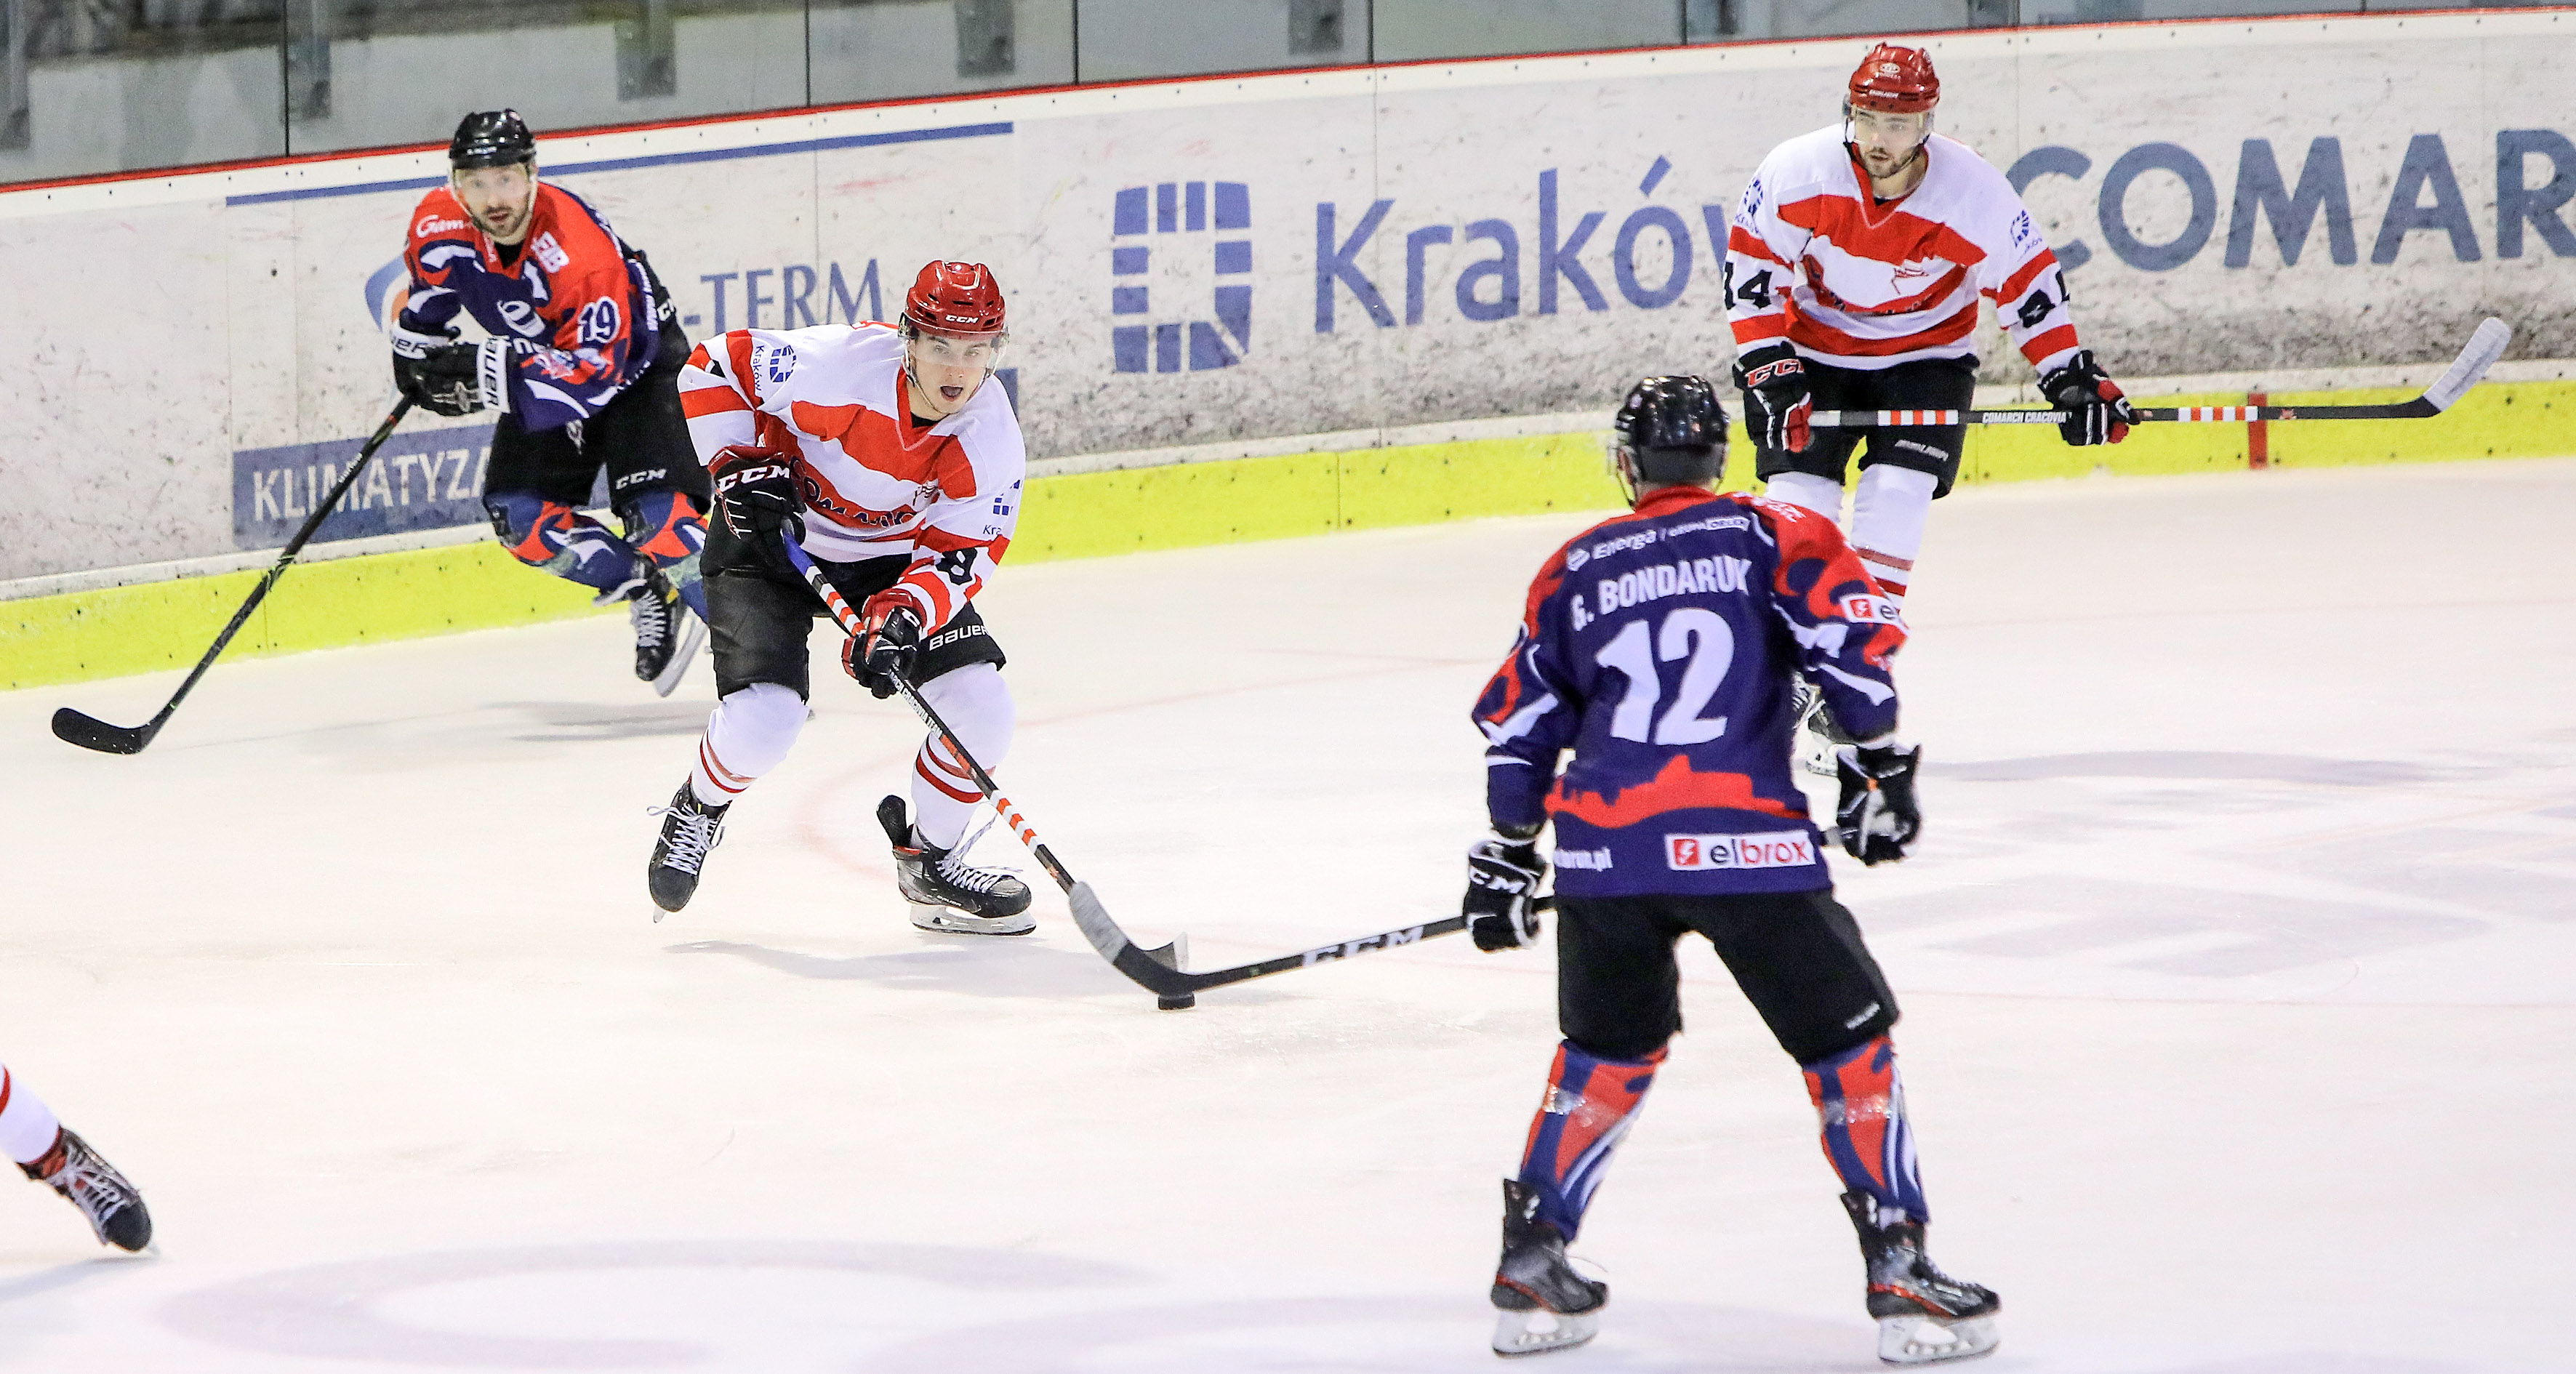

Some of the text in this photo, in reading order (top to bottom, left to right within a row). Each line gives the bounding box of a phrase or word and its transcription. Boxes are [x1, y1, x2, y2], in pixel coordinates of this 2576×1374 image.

[577, 296, 622, 344] 19
[945, 314, 979, 324] CCM
[753, 345, 764, 391] Kraków
[1982, 411, 2067, 424] COMARCH CRACOVIA
[615, 468, 667, 490] CCM
[718, 465, 790, 493] CCM
[1597, 608, 1735, 745] 12
[902, 687, 929, 724] CRACOVIA
[1710, 837, 1810, 865] elbrox
[1301, 925, 1424, 968] CCM
